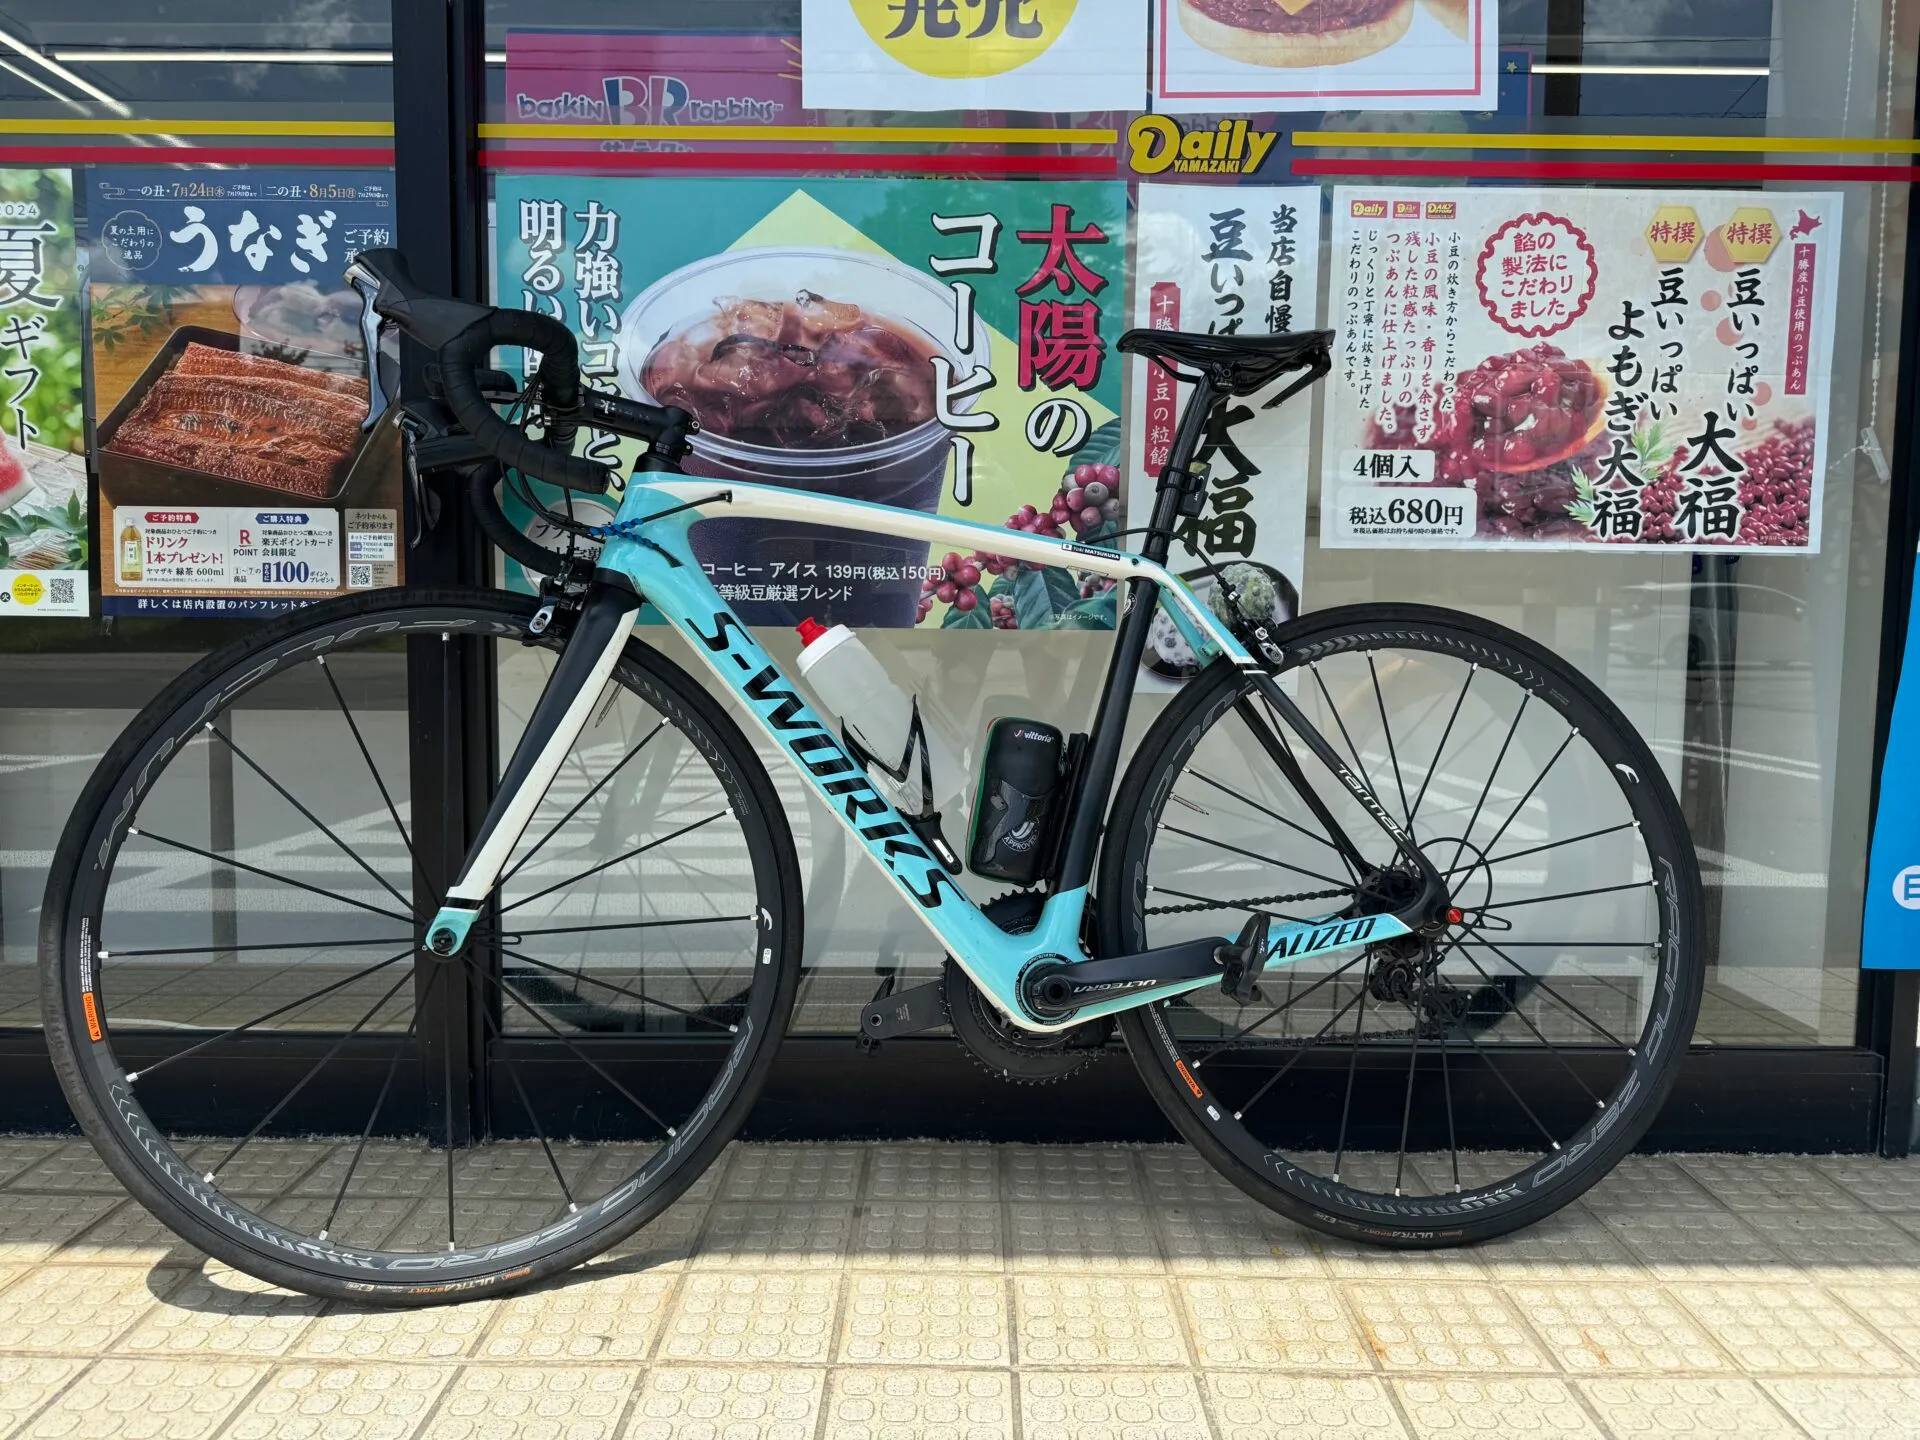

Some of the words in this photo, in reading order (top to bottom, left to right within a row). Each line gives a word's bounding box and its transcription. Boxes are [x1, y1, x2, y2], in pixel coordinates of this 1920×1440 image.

[517, 92, 604, 121] baskin
[602, 76, 690, 126] BR
[1127, 114, 1281, 174] Daily
[1174, 160, 1240, 173] YAMAZAKI
[0, 204, 38, 217] 024
[1353, 202, 1384, 216] Daily
[110, 225, 154, 236] 夏の土用に
[170, 205, 337, 273] うなぎ
[344, 229, 390, 245] ご予約
[1650, 221, 1696, 245] 特撰
[1726, 221, 1773, 245] 特撰
[112, 237, 154, 248] こだわりの
[1514, 232, 1556, 253] 餡の
[122, 249, 143, 260] 逸品
[1502, 254, 1568, 275] 製法に
[1501, 275, 1574, 297] こだわり
[1344, 230, 1361, 388] こだわりのつぶあんです。
[1359, 230, 1378, 409] じっくりと丁寧に炊き上げた
[1399, 232, 1421, 404] 残した粒感たっぷりの
[1510, 298, 1566, 319] ました
[1790, 246, 1811, 390] 十勝産小豆使用のつぶあん
[1015, 204, 1109, 457] 太陽の
[1379, 232, 1401, 430] つぶあんに仕上げました。
[1441, 232, 1461, 409] 小豆の炊き方からこだわった
[1417, 232, 1440, 439] 小豆の風味・香りを余さず
[1650, 267, 1688, 421] 豆いっぱい
[1726, 267, 1765, 422] 豆いっぱい
[929, 212, 1003, 505] コーヒー
[1591, 300, 1647, 538] よもぎ大福
[1353, 453, 1420, 478] 4個入
[1674, 412, 1745, 539] 大福
[152, 514, 192, 522] ご予約特典
[262, 515, 303, 524] ご購入特典
[355, 512, 387, 520] ネットからも
[1349, 498, 1463, 525] 税込680円
[348, 521, 394, 529] ご予約承ります
[146, 537, 188, 549] ドリンク
[239, 529, 252, 545] R
[262, 537, 334, 547] 楽天ポイントカード
[262, 548, 296, 557] 会員限定
[176, 567, 194, 576] 緑茶
[196, 568, 224, 576] 600ml
[273, 561, 309, 583] 100
[770, 562, 818, 579] アイス
[825, 564, 947, 581] 139円(税込150円)
[138, 598, 319, 612] 詳しくは店内設置のパンフレットを
[1024, 731, 1053, 743] vittoria
[684, 611, 966, 909] S-WORKS
[1338, 763, 1410, 842] Tarmac
[1266, 917, 1377, 961] ALIZED
[1073, 979, 1157, 993] ULTEGRA
[85, 996, 97, 1030] WARNING
[445, 1276, 496, 1292] ULTRA
